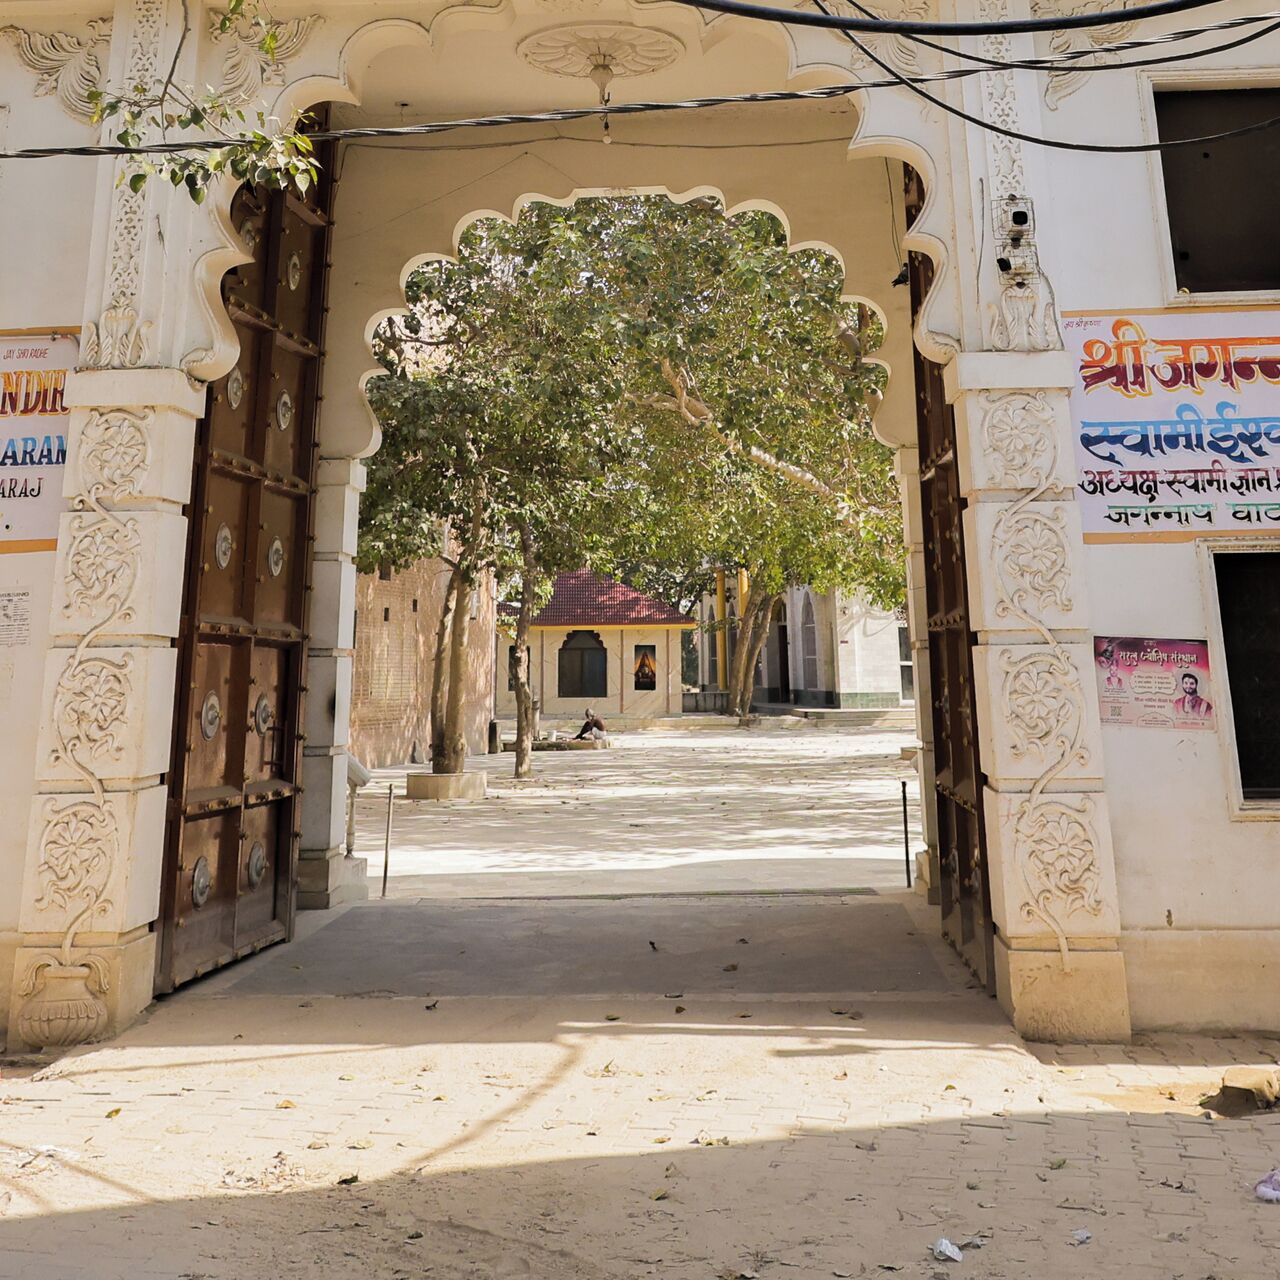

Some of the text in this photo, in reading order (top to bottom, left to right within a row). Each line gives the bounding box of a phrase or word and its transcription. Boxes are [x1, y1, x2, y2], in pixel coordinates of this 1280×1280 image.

[1079, 318, 1150, 398] श्री
[1080, 403, 1207, 466] स्वामी
[1230, 467, 1273, 496] ज्ञान
[1104, 504, 1216, 527] जगन्नाथ
